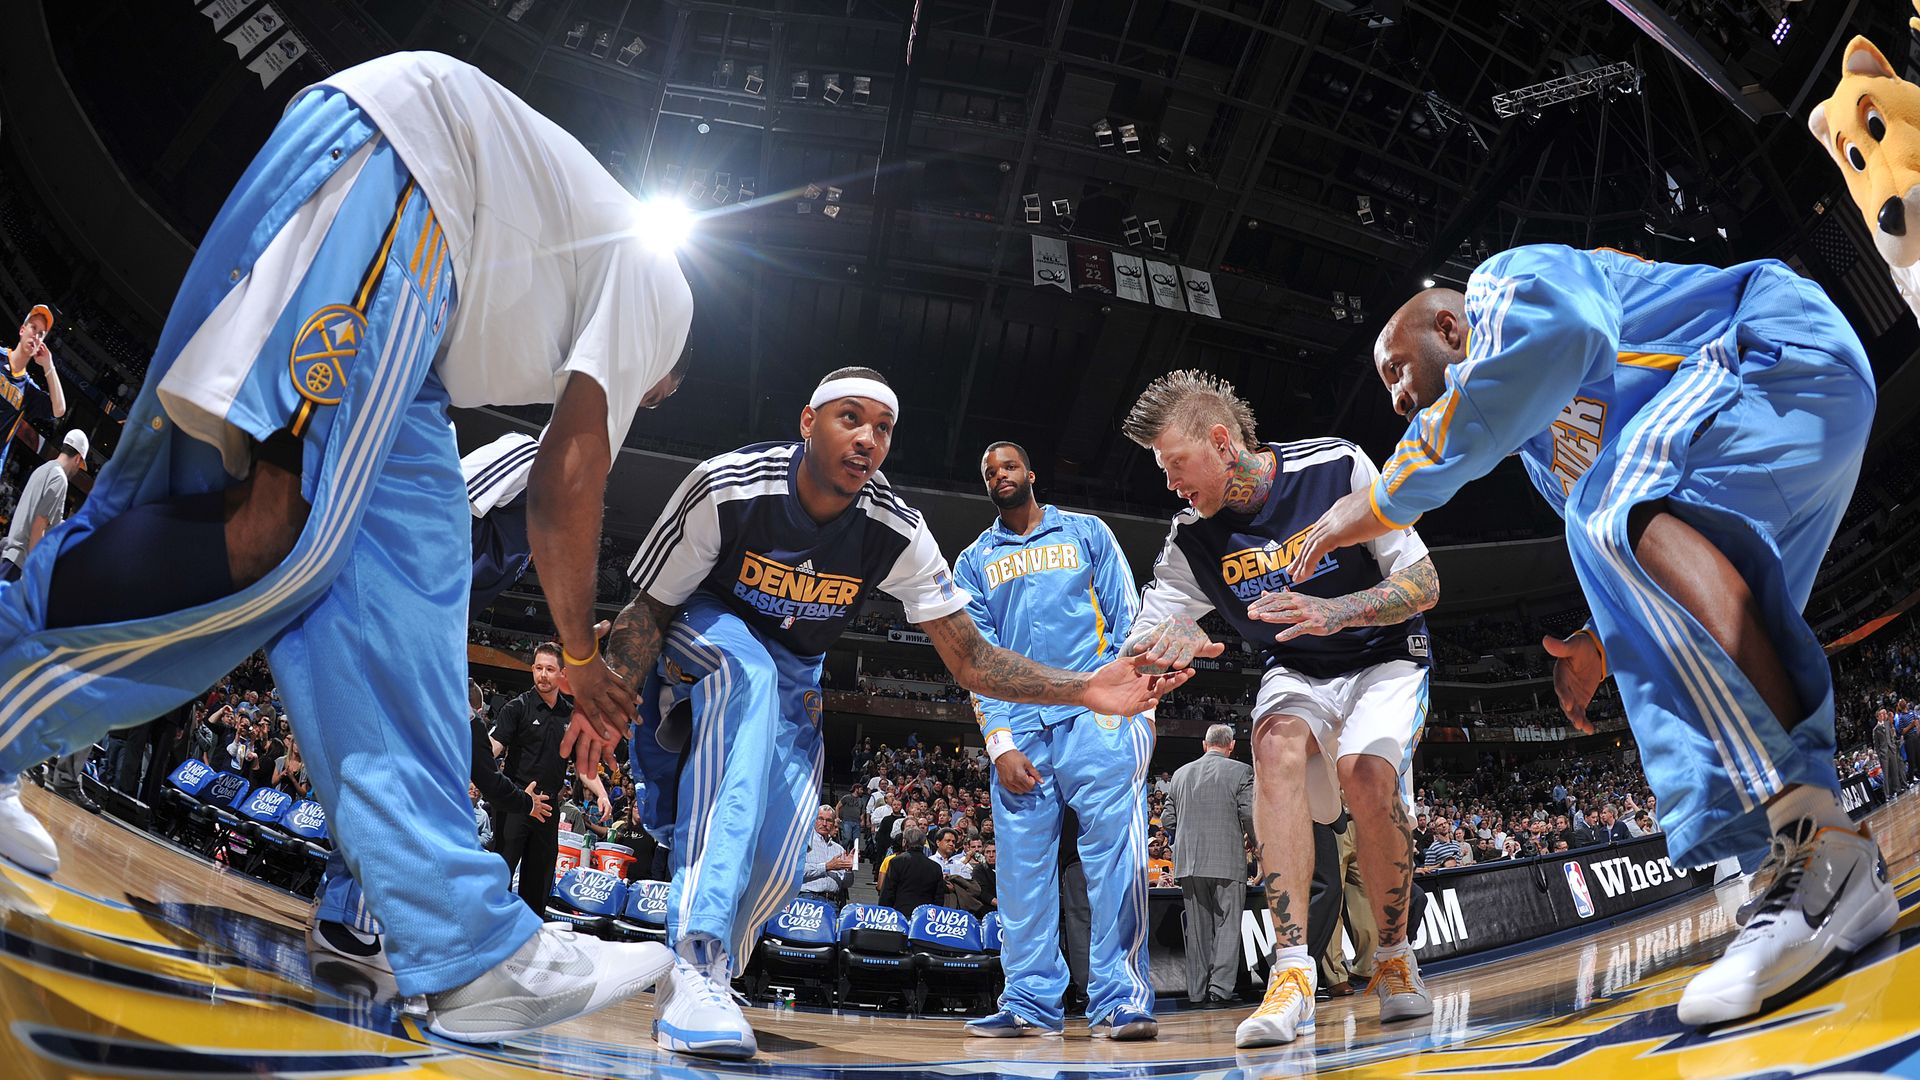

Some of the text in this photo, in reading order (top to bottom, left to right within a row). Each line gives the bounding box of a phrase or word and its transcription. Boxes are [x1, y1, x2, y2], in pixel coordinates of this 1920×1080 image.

[1085, 268, 1102, 280] 22
[1550, 396, 1608, 497] VER
[1222, 533, 1308, 585] DENVE
[795, 566, 816, 576] adidas
[984, 544, 1078, 592] DENVER
[1229, 552, 1338, 598] BASKETLL
[738, 556, 859, 605] DENVER
[733, 581, 847, 618] BASKETBALL
[905, 634, 931, 644] www.a
[178, 770, 200, 784] Cares
[189, 763, 209, 778] NBA
[211, 784, 237, 798] Cares
[221, 776, 244, 790] NBA
[251, 799, 278, 813] Cares
[262, 791, 286, 805] NBA
[294, 813, 323, 827] Cares
[583, 872, 617, 892] NBA
[569, 883, 611, 901] Cares
[649, 885, 670, 900] NB
[637, 897, 667, 912] Car
[789, 900, 824, 919] NBA
[778, 913, 821, 929] Cares
[864, 907, 898, 924] NBA
[936, 910, 969, 927] NBA
[925, 921, 968, 937] Cares
